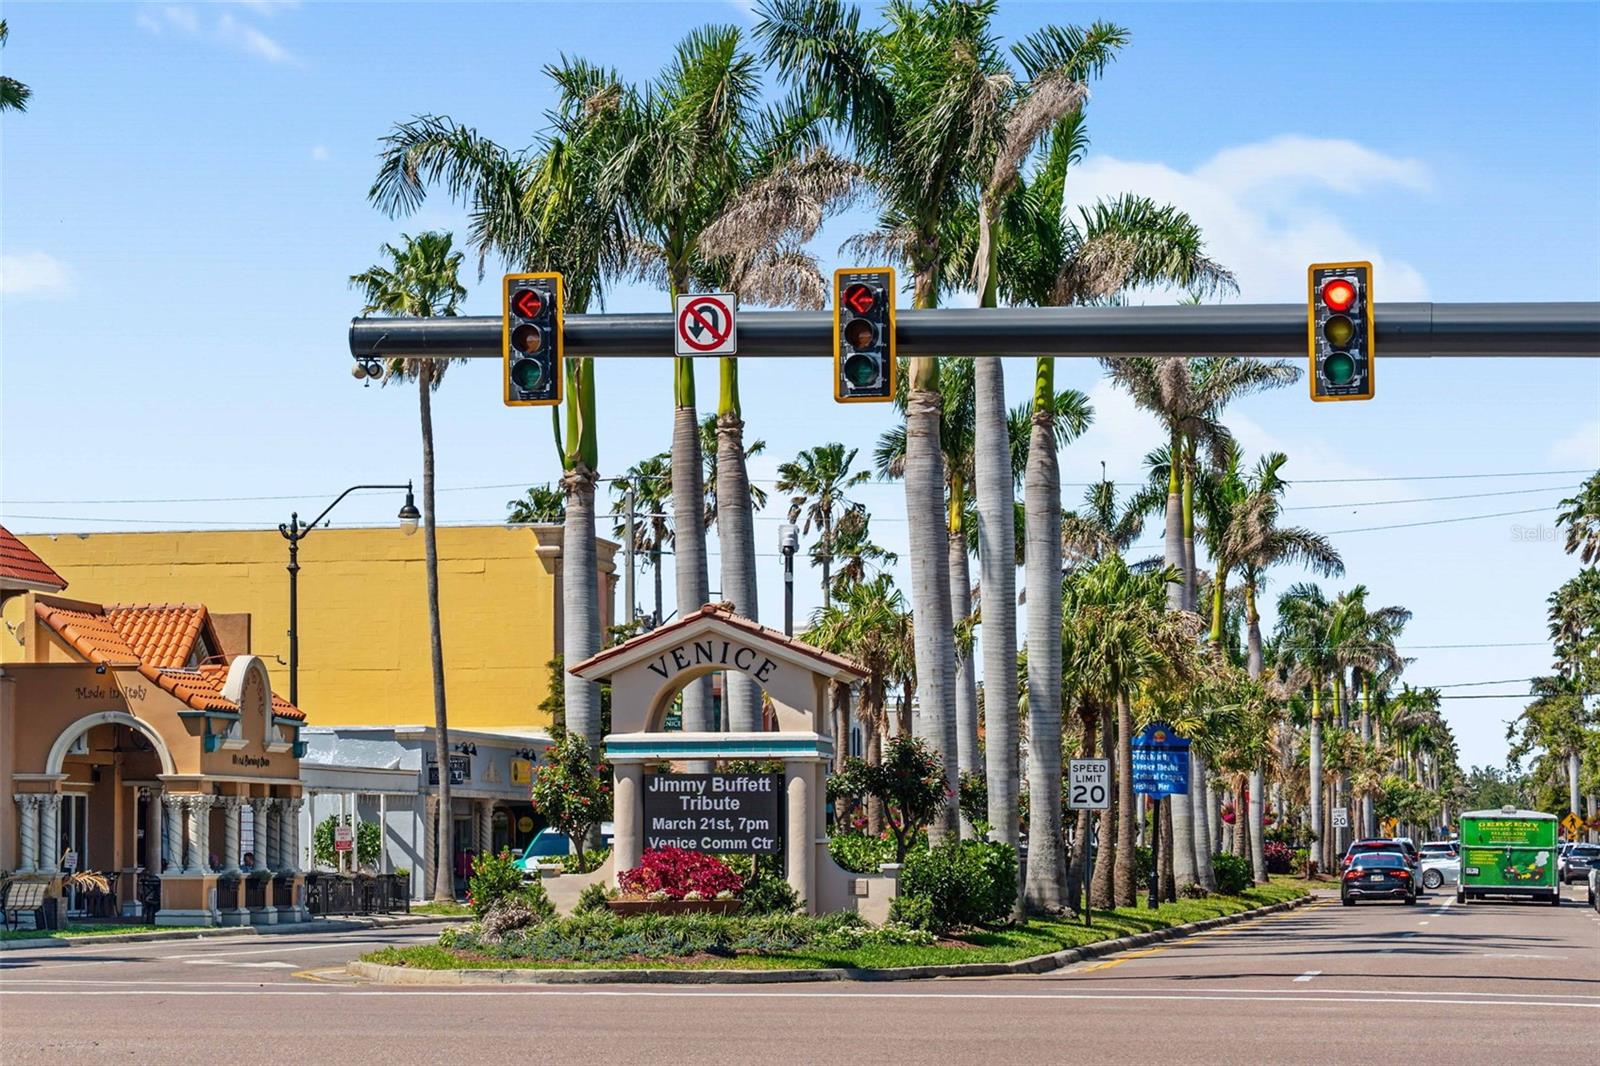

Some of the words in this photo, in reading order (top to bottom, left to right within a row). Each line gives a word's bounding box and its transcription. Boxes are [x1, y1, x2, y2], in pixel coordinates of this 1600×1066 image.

[647, 640, 777, 683] VENICE
[75, 685, 104, 699] Made
[123, 685, 147, 701] Italy
[1073, 764, 1106, 773] SPEED
[649, 777, 706, 795] Jimmy
[712, 777, 771, 792] Buffett
[1076, 775, 1102, 783] LIMIT
[1073, 785, 1106, 803] 20
[680, 796, 740, 810] Tribute
[652, 818, 696, 830] March
[700, 818, 734, 832] 21st,
[738, 818, 769, 833] 7pm
[1333, 817, 1346, 825] 20
[649, 837, 697, 849] Venice
[701, 837, 747, 849] Comm
[751, 837, 774, 849] Ctr
